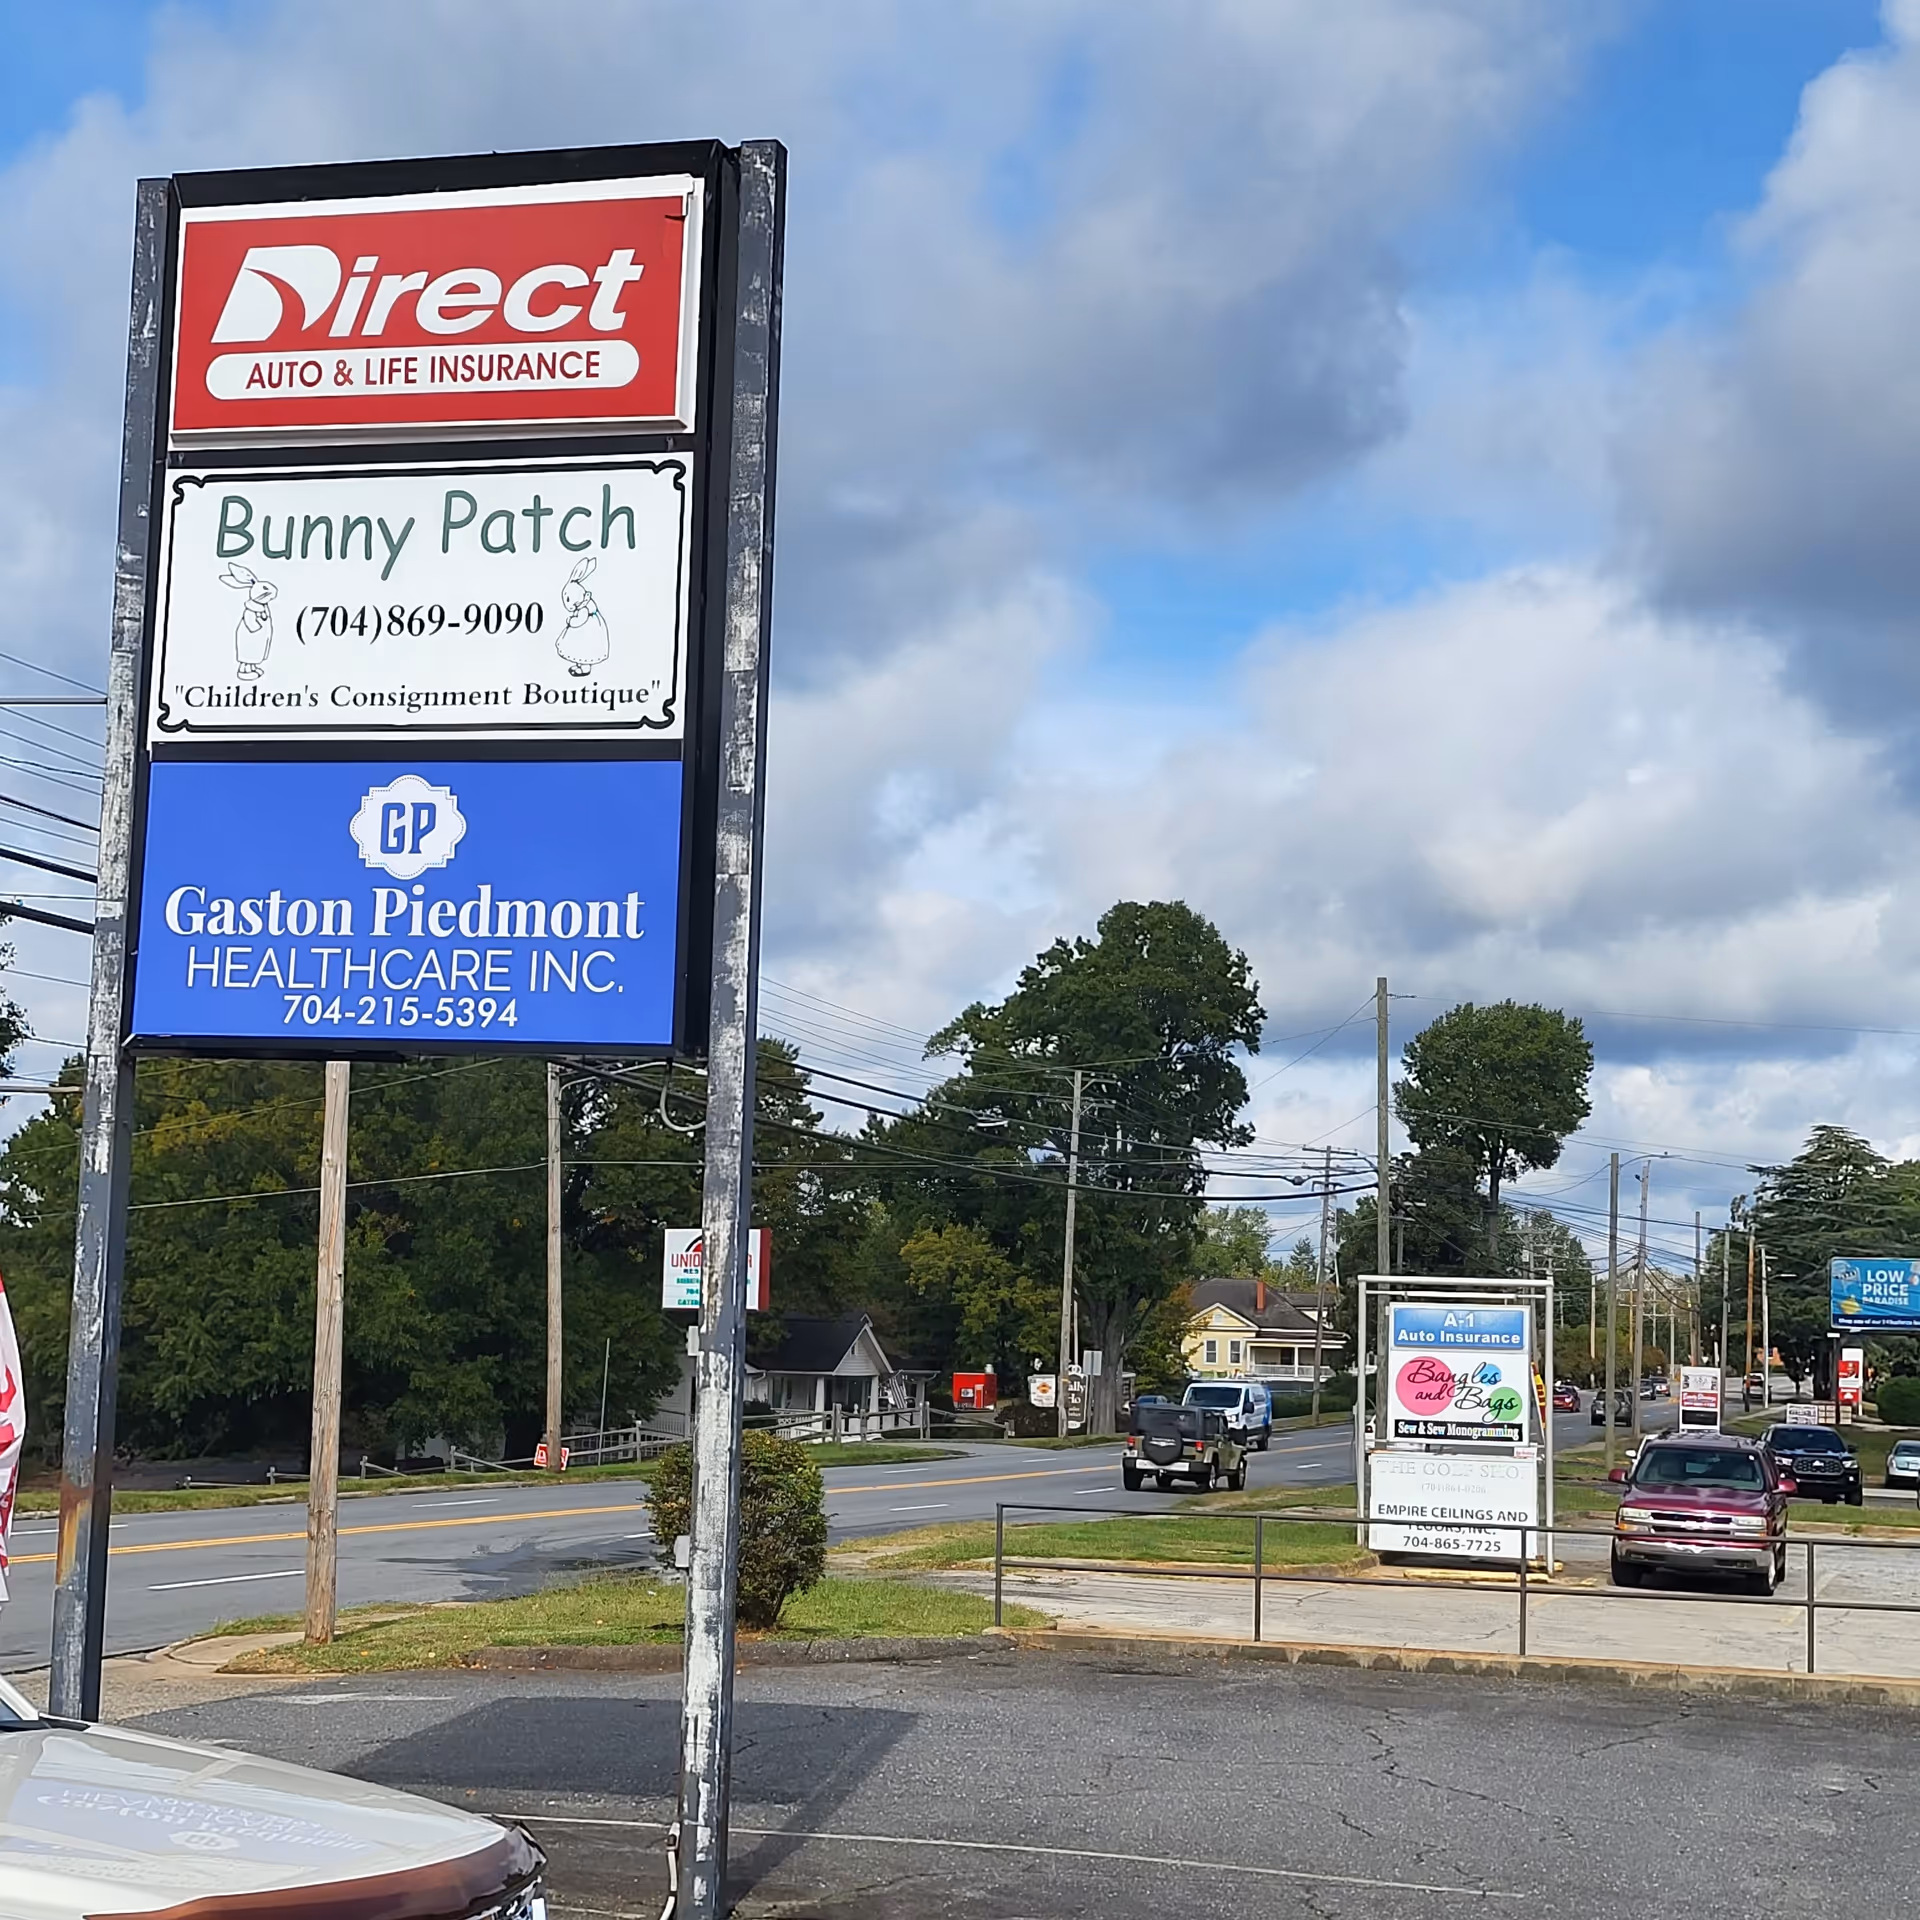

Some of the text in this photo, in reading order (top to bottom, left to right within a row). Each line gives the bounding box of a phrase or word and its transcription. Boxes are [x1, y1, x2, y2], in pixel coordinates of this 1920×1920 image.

[211, 244, 644, 343] Direct
[245, 350, 601, 389] AUTO & LIFE INSURANCE
[216, 483, 636, 581] Bunny Patch
[295, 602, 544, 645] (704)869-9090
[175, 680, 661, 714] "Children's Consignment Boutique"
[379, 801, 437, 855] GP
[164, 883, 645, 940] Gaston Piedmont
[186, 946, 624, 993] HEALTHCARE INC.
[283, 995, 518, 1028] 704-215-5394
[1862, 1283, 1909, 1296] PRICE
[1866, 1269, 1905, 1283] LOW
[1397, 1329, 1520, 1344] Auto Insurance
[1443, 1312, 1475, 1328] A-1
[1068, 1381, 1086, 1394] ally
[1407, 1359, 1502, 1397] Bangles
[1415, 1383, 1449, 1401] and
[1454, 1386, 1519, 1424] Bags
[1398, 1421, 1520, 1440] Sew & Sew Monogramming
[1377, 1503, 1529, 1523] EMPIRE CEILINGS AND
[1402, 1535, 1502, 1553] 704-865-7725
